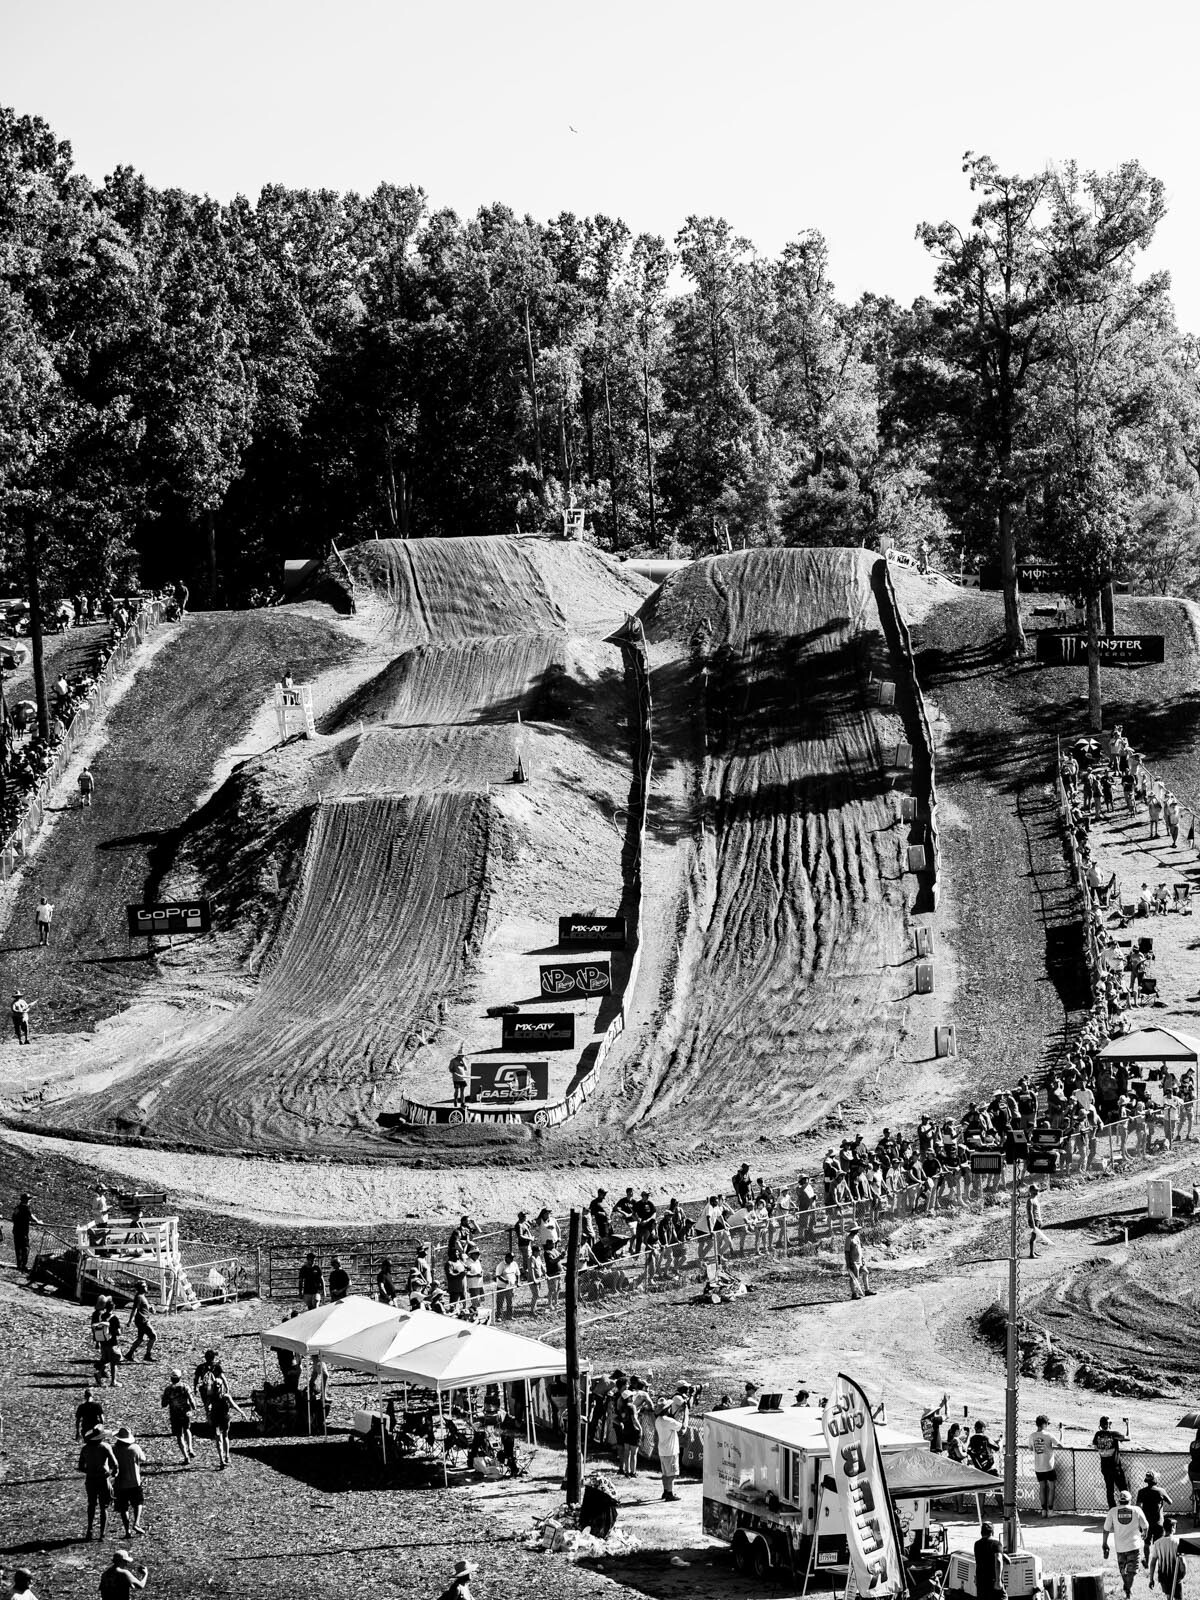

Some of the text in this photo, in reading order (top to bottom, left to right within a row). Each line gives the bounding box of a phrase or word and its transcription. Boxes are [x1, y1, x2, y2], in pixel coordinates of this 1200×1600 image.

[1081, 640, 1143, 650] MNSTER
[137, 907, 201, 920] GoPro
[514, 1022, 556, 1031] MX-ATV
